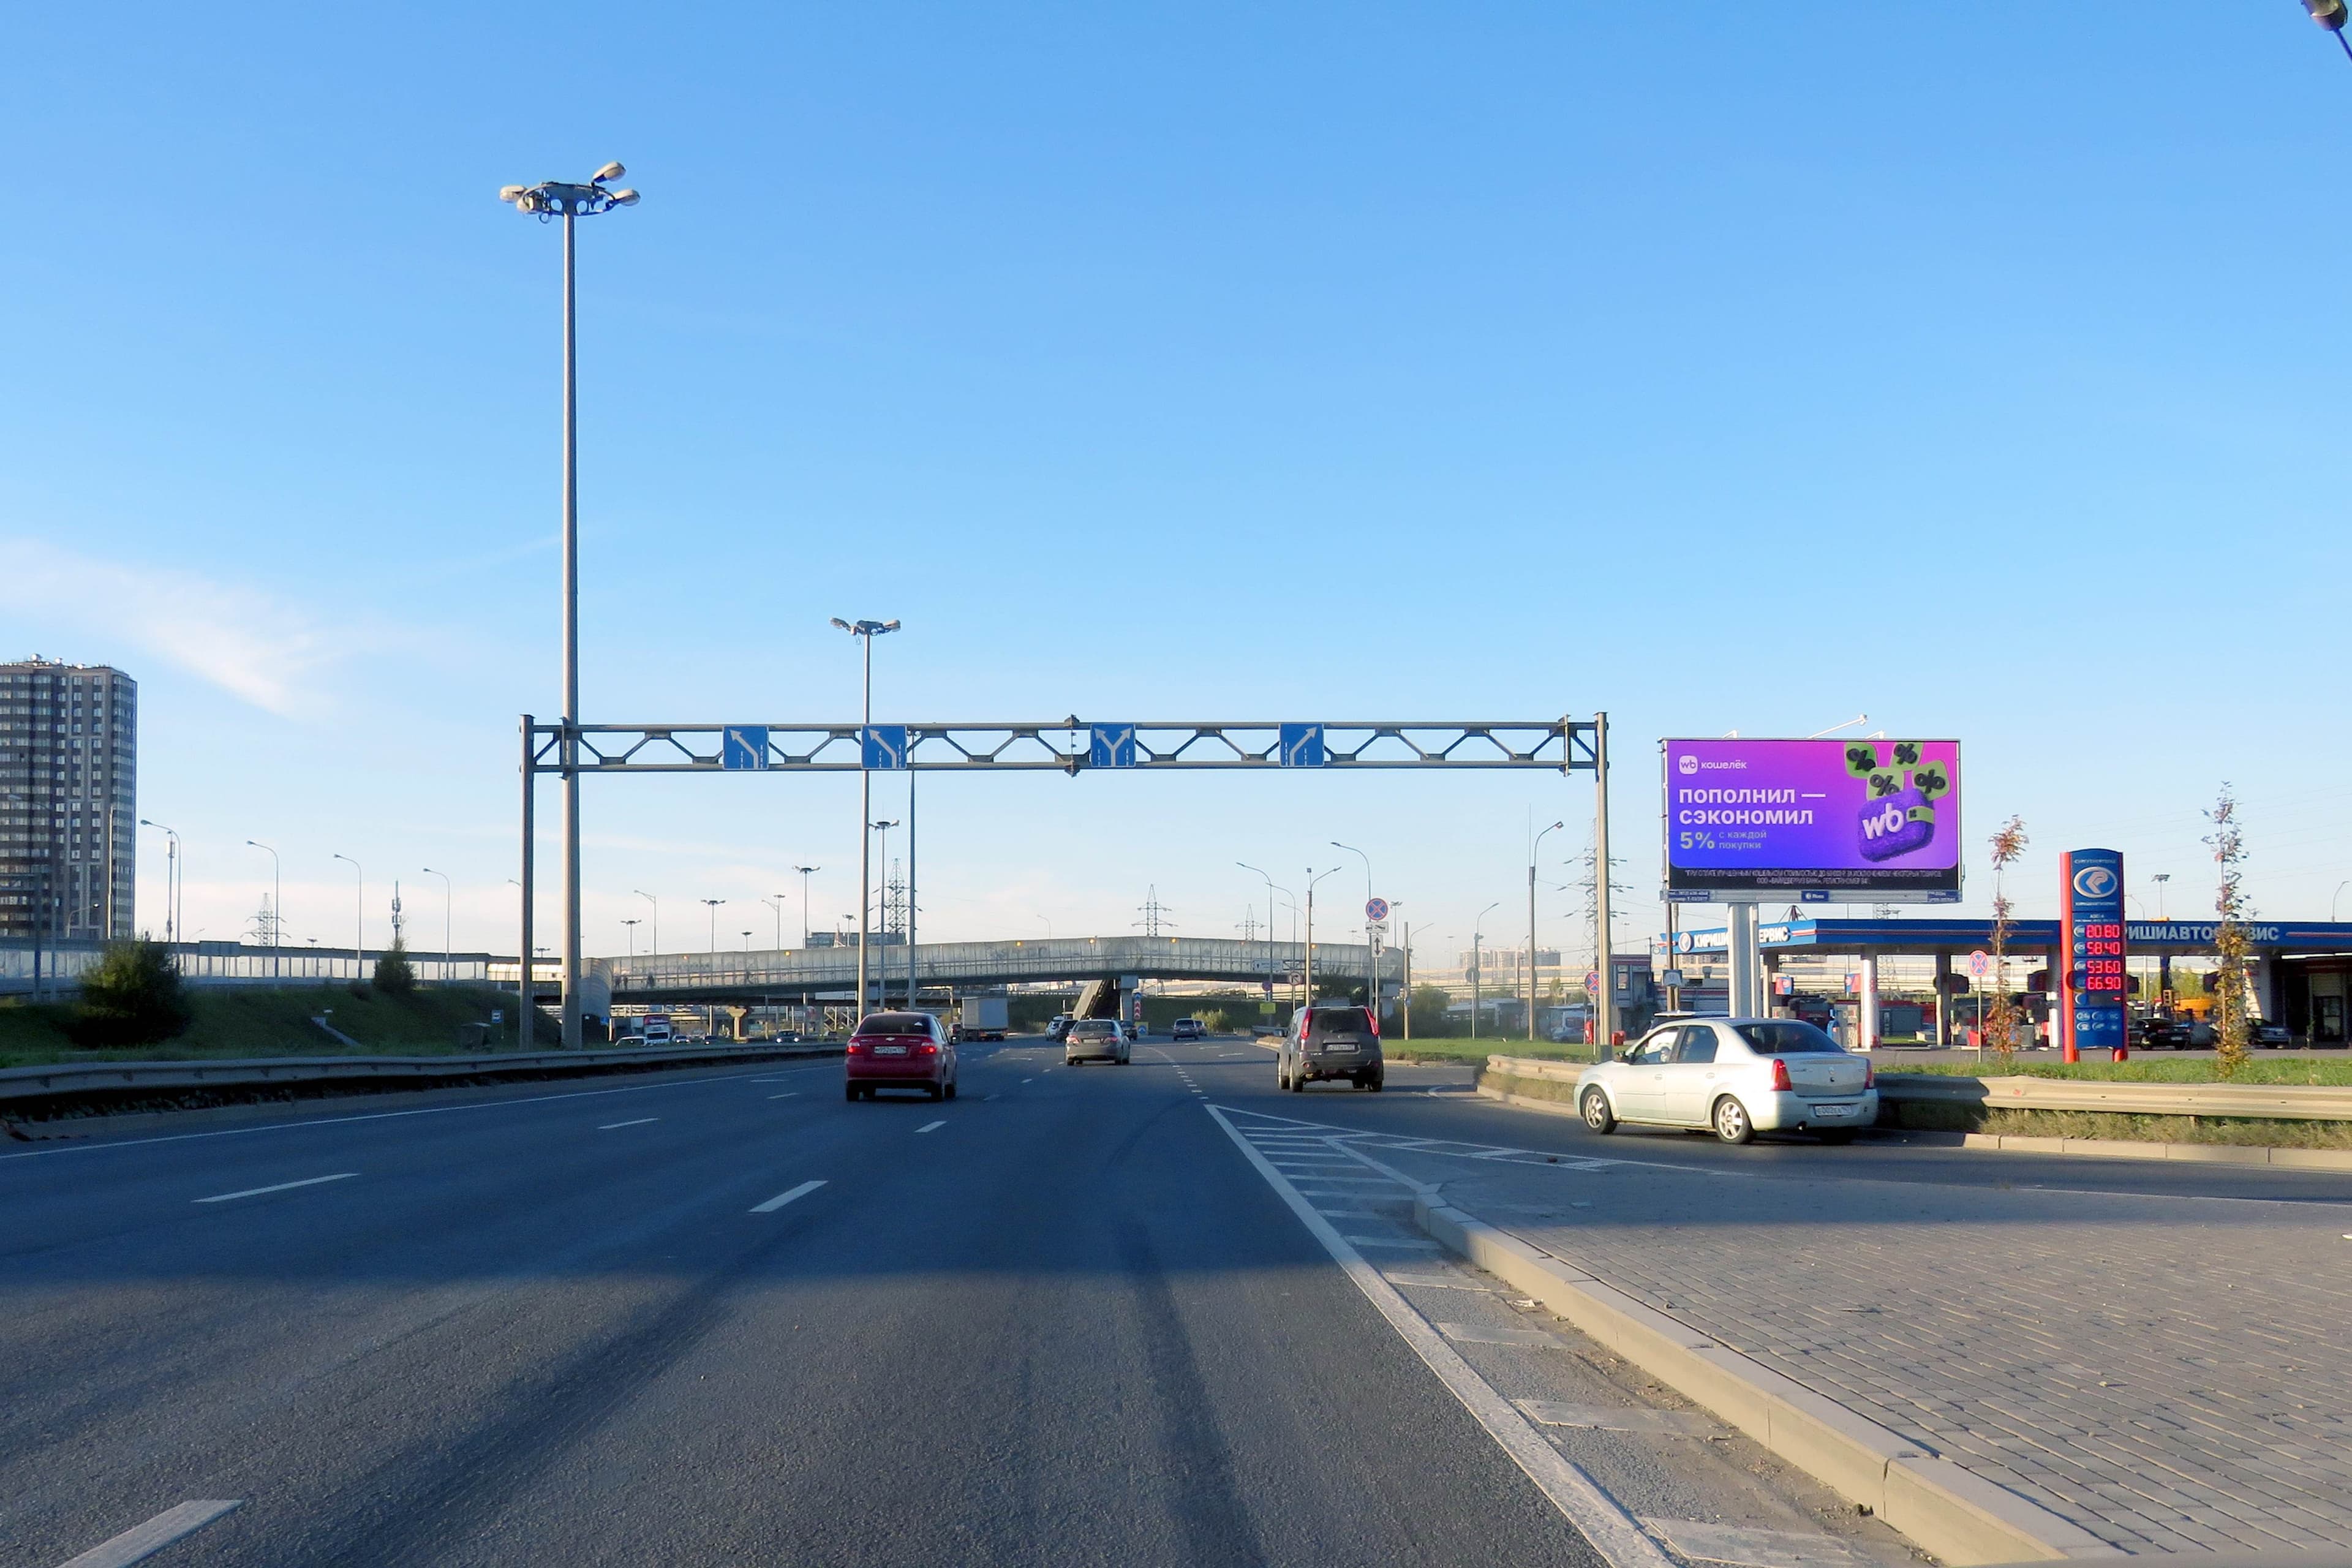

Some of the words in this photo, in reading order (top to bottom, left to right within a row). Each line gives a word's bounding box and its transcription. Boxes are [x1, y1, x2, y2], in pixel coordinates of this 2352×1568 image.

[1681, 760, 1696, 769] wb
[1701, 760, 1747, 769] кошелёк
[1679, 789, 1795, 804] ПОПОЛНИЛ
[1679, 810, 1813, 824] СЭКОНОМИЛ
[1862, 802, 1904, 840] wb
[1681, 831, 1715, 850] 5%
[1727, 830, 1766, 840] каждой
[1719, 842, 1762, 851] покупки
[2087, 941, 2120, 954] 58.40
[2087, 960, 2120, 973] 53.60
[2087, 976, 2121, 989] 66.90
